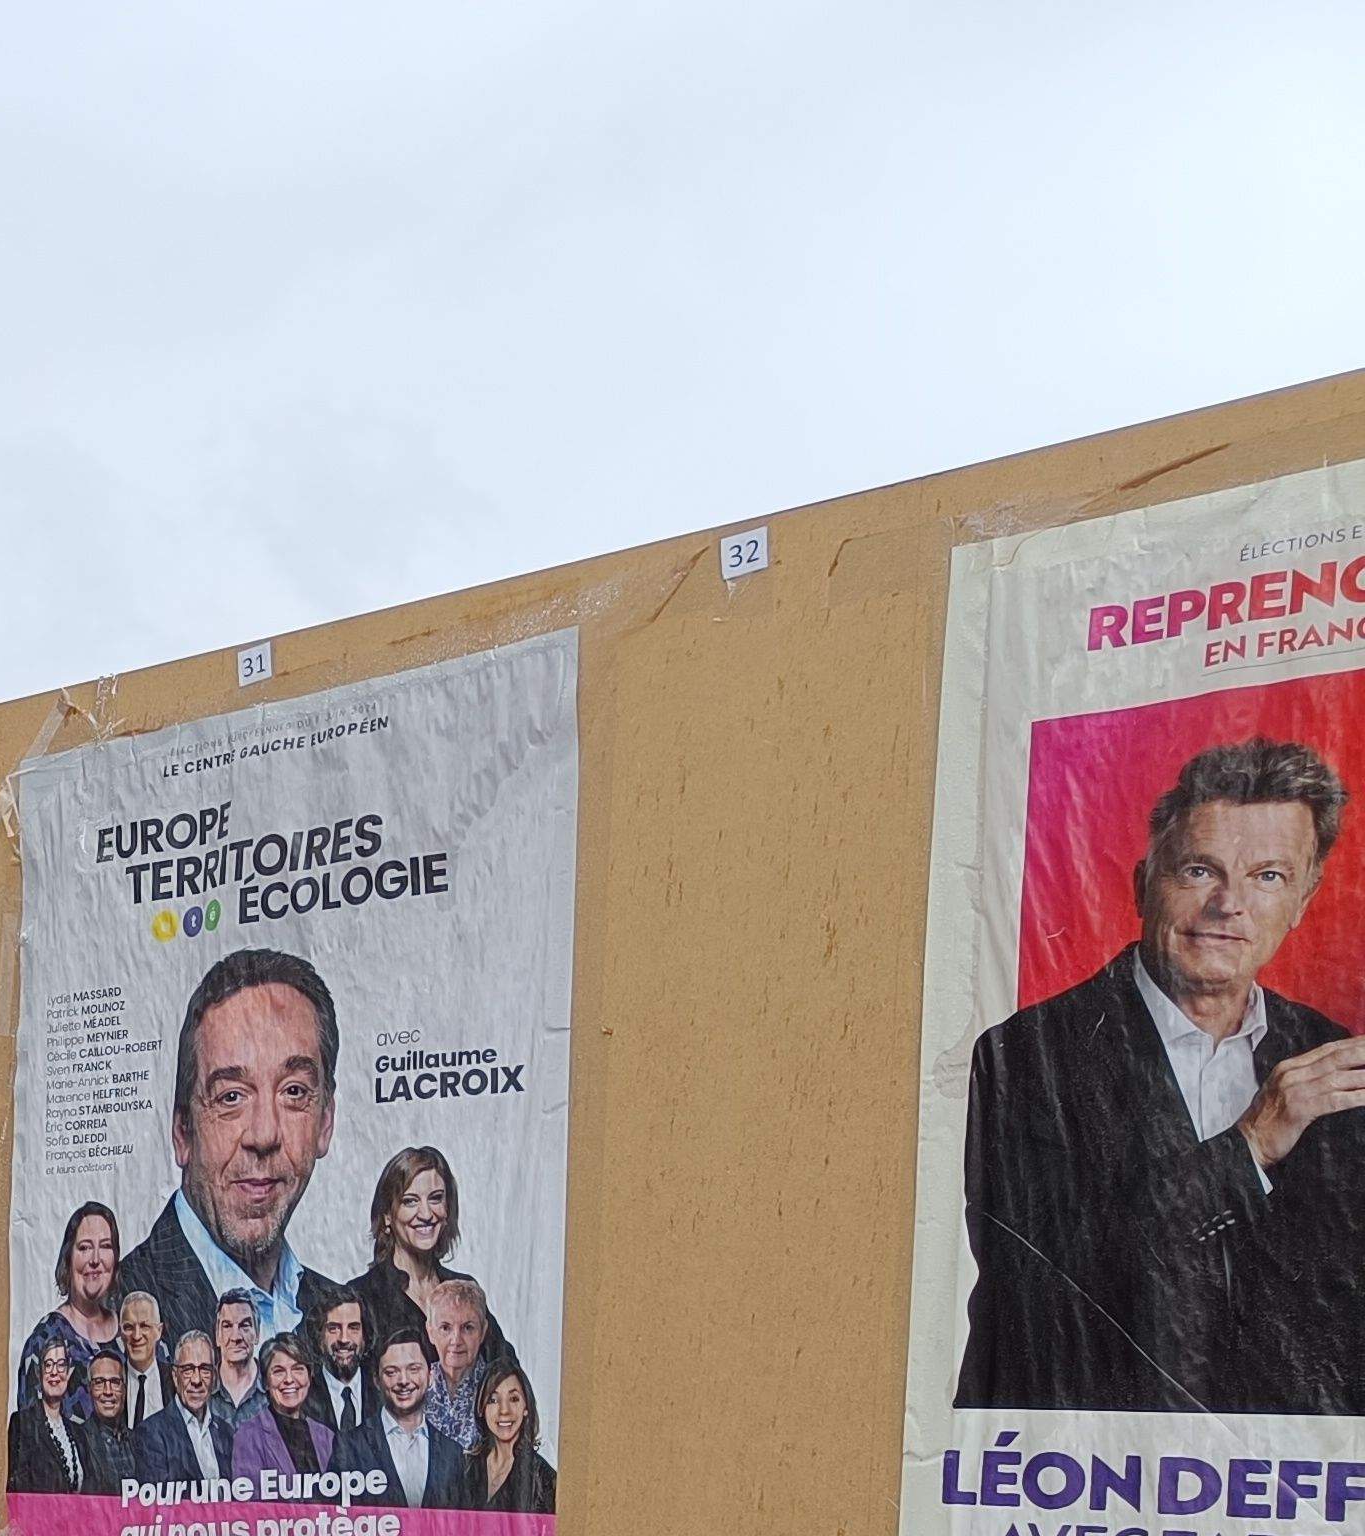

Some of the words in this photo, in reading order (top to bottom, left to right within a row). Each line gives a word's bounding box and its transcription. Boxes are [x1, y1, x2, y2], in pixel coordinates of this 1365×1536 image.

[729, 539, 760, 568] 32
[1239, 528, 1346, 562] ÉLECTIONS
[1204, 633, 1246, 668] EN
[243, 653, 266, 678] 31
[163, 763, 179, 778] LE
[184, 749, 236, 774] CENTRE
[239, 736, 306, 759] GAUCHE
[310, 715, 389, 748] EUROPÉEN
[96, 800, 232, 864] EUROPE
[125, 813, 383, 904] TERRITOIRES
[238, 852, 449, 925] ÉCOLOGIE
[73, 986, 122, 1002] MASSARD
[46, 1007, 80, 1020] Patrick
[83, 1015, 122, 1030] MÉADEL
[87, 1029, 129, 1044] MEYNIER
[376, 1029, 421, 1047] avec
[79, 1040, 163, 1059] CAILLOU-ROBERT
[375, 1046, 498, 1074] Guillaume
[46, 1065, 71, 1077] Sven
[72, 1060, 112, 1074] FRANCK
[112, 1070, 150, 1084] BARTHE
[92, 1086, 138, 1101] HELFRICH
[375, 1065, 525, 1104] LACROIX
[65, 1118, 108, 1132] CORREIA
[72, 1132, 107, 1145] DJEDDI
[88, 1144, 134, 1158] BÉCHIEAU
[941, 1431, 1141, 1513] LÉON
[121, 1477, 187, 1508] Pour
[189, 1476, 254, 1504] une
[259, 1469, 388, 1508] Europe
